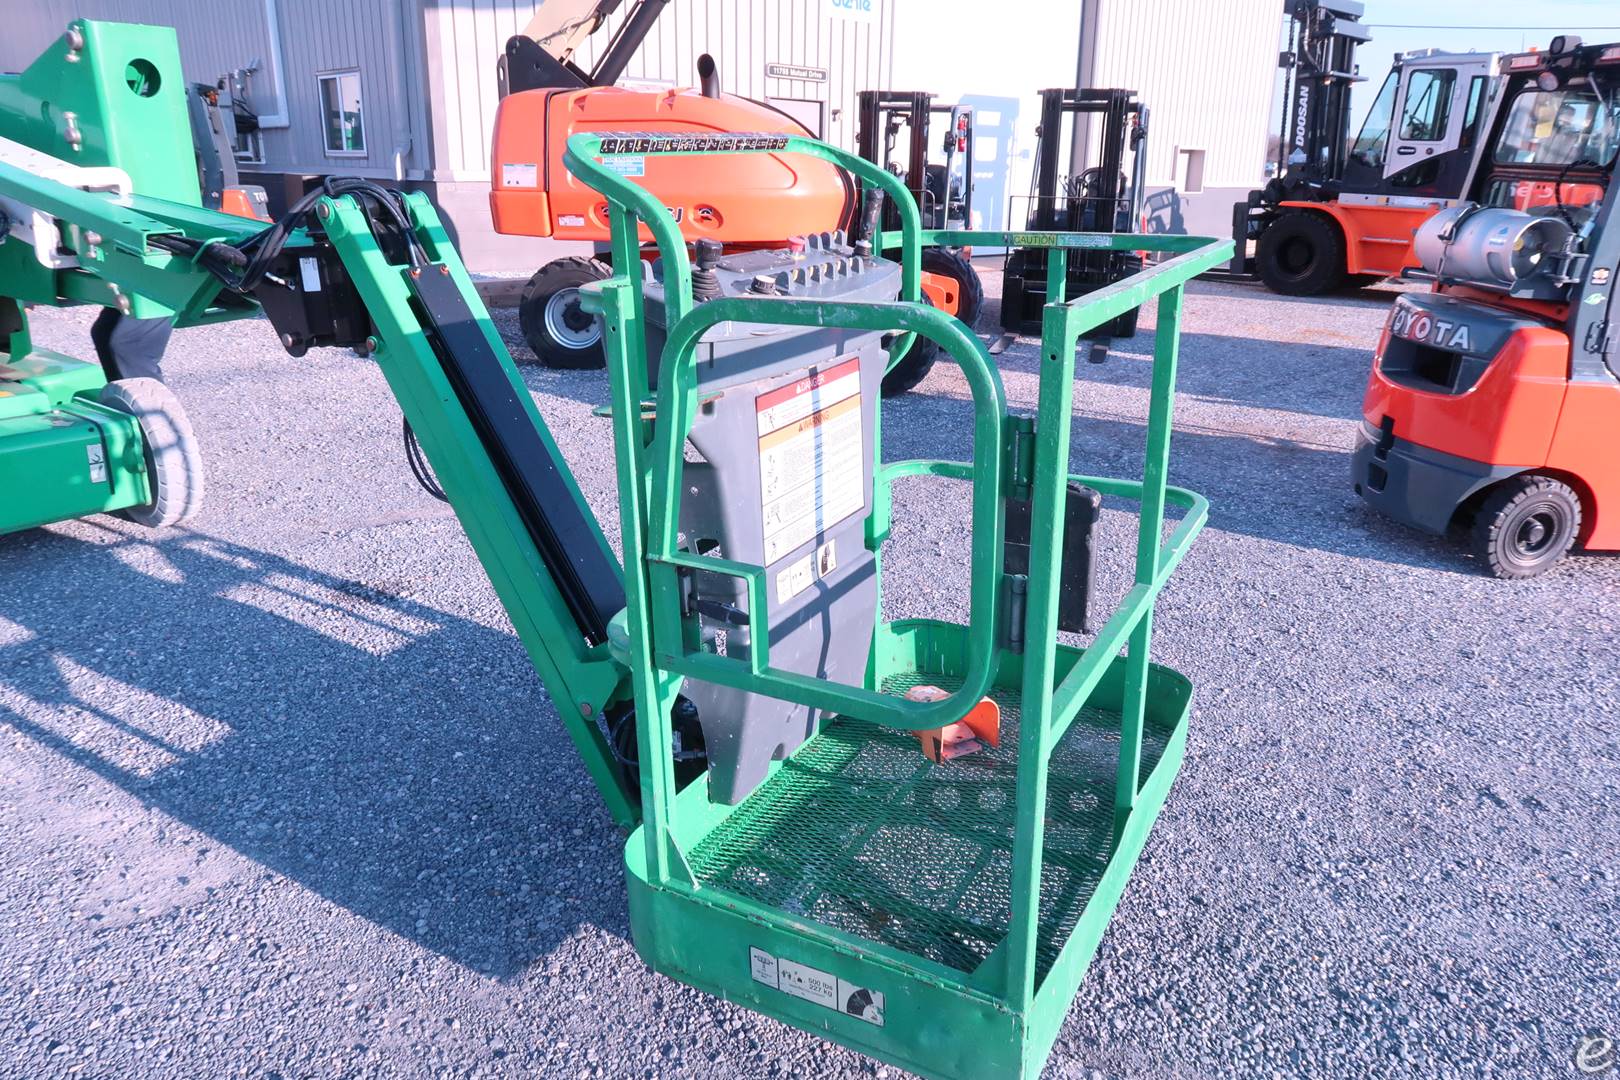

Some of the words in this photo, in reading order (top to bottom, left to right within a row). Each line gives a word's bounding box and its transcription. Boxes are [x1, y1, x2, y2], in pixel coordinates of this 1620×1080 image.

[1296, 86, 1309, 147] DOOSAN
[1014, 235, 1055, 245] CAUTION
[800, 374, 825, 391] DANGER
[804, 411, 831, 429] WARNING
[822, 981, 833, 990] lbs
[823, 988, 833, 998] kg
